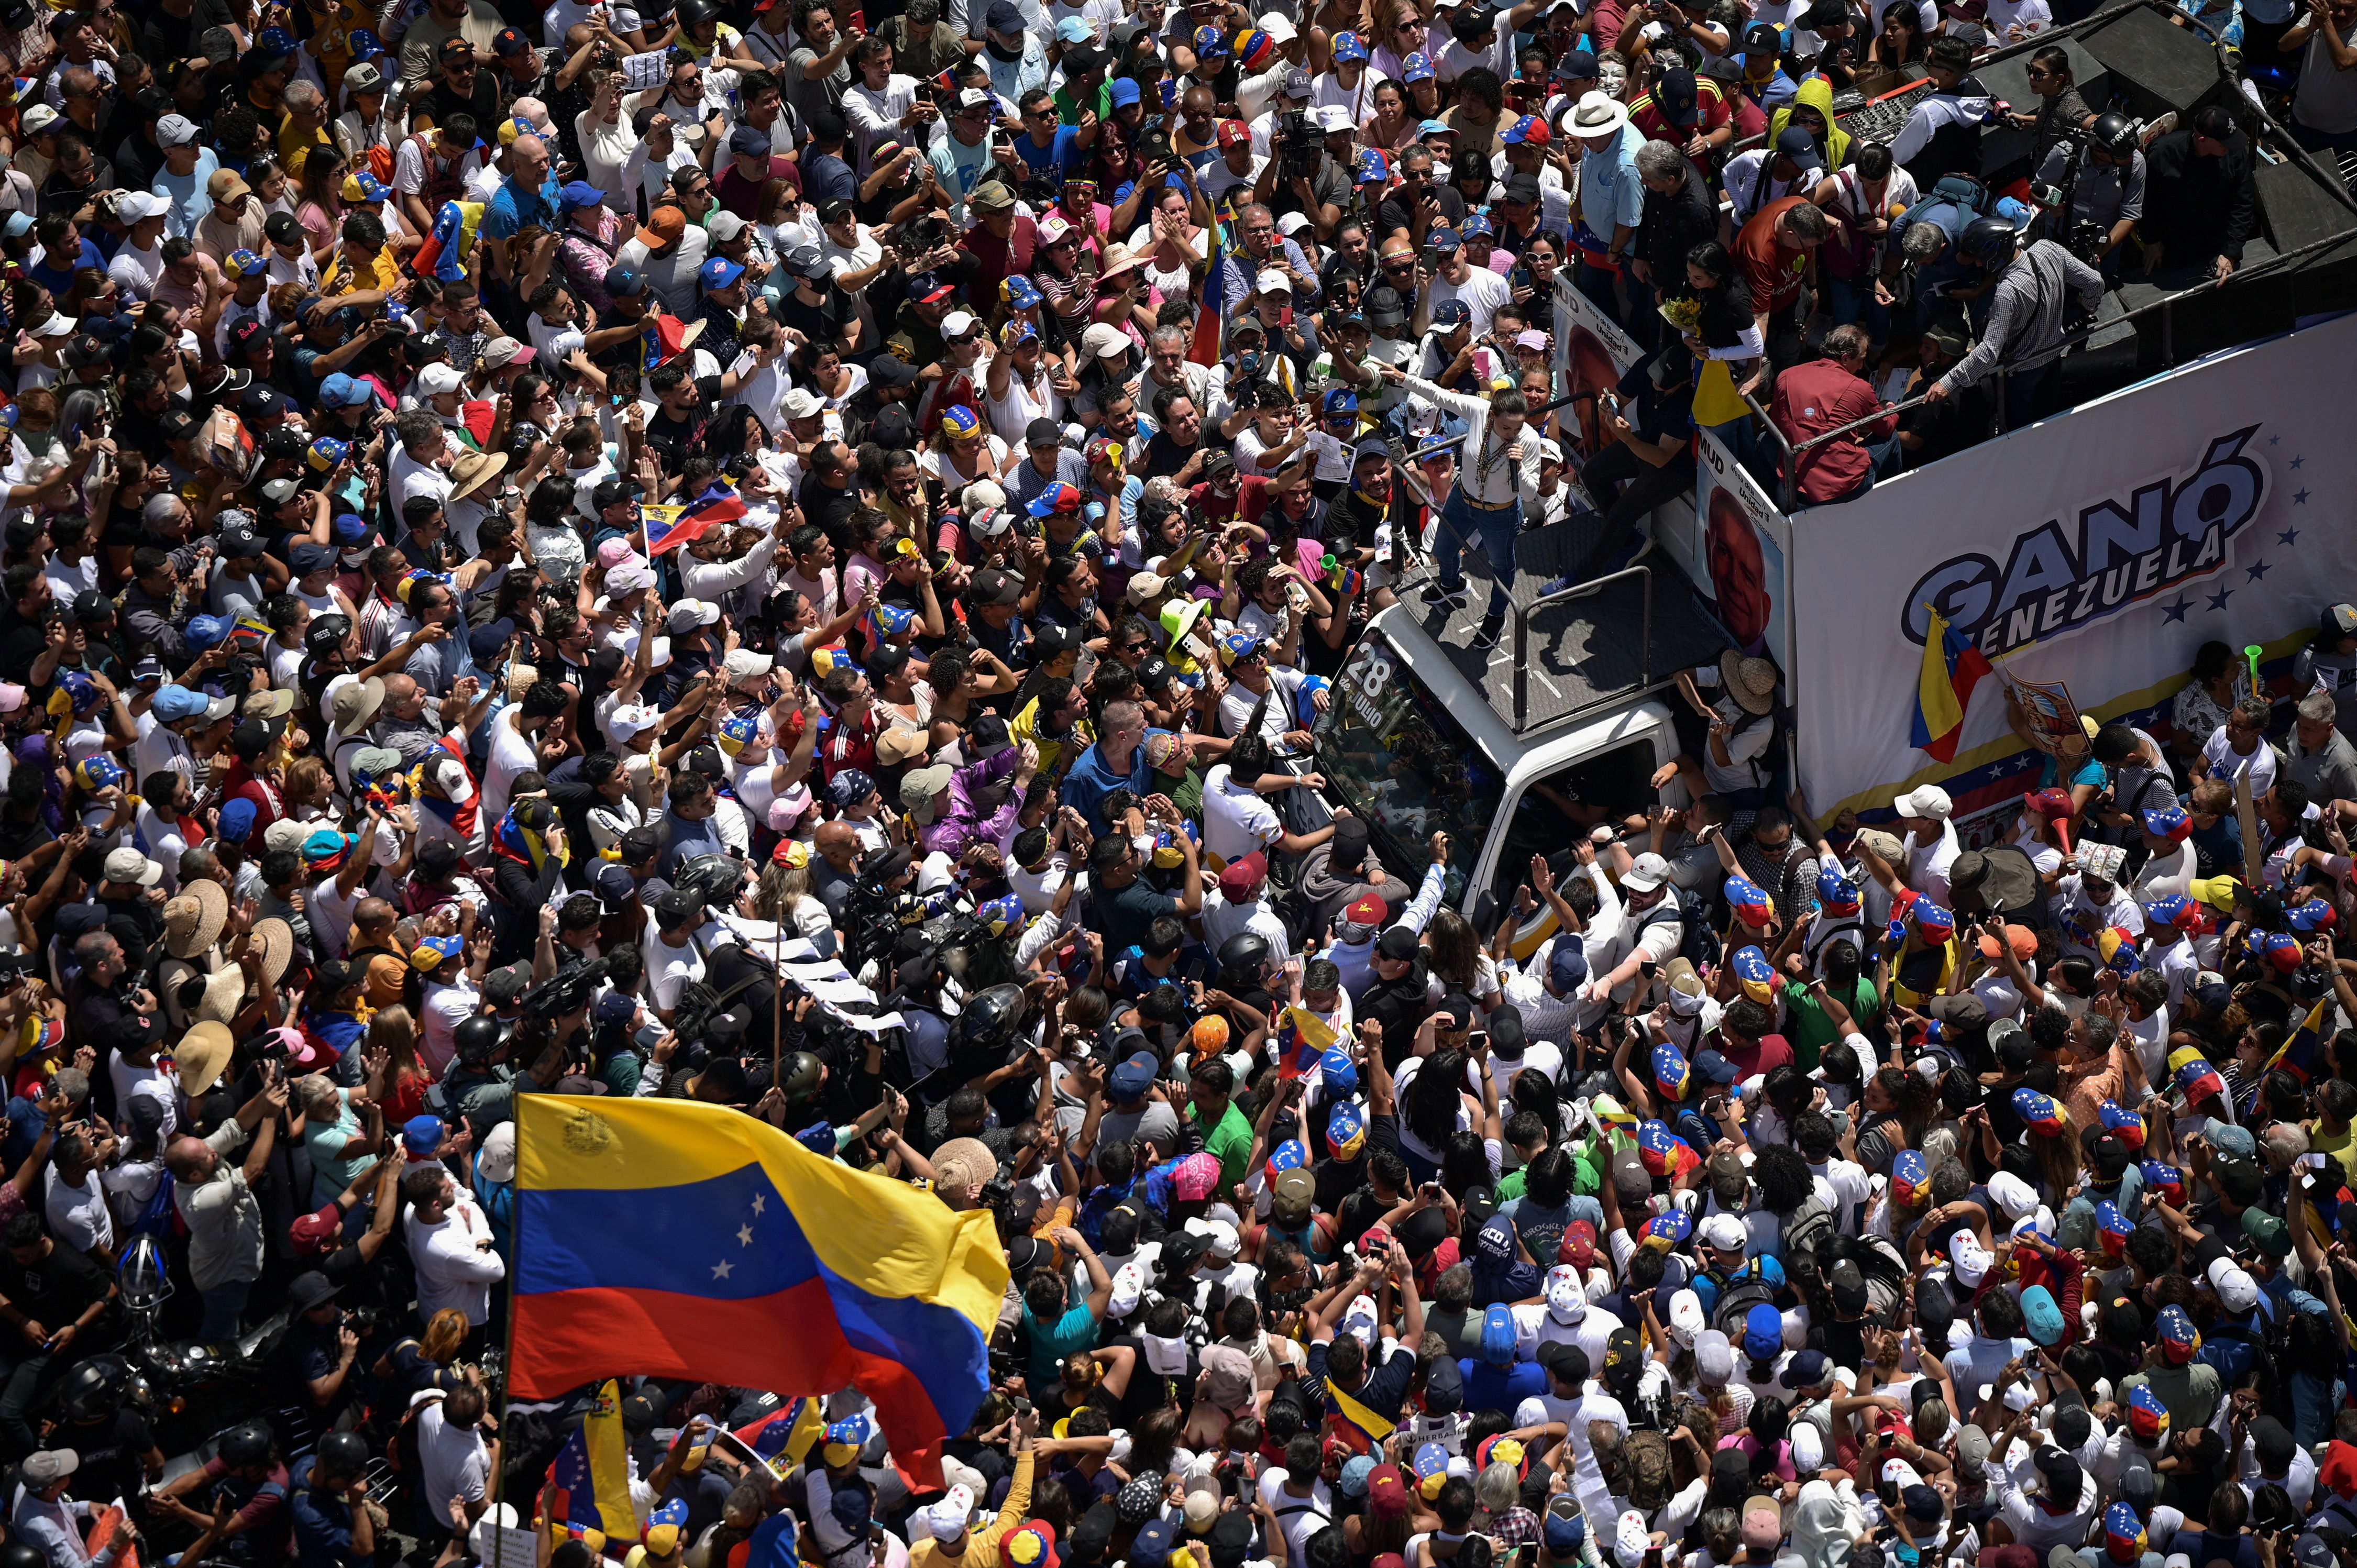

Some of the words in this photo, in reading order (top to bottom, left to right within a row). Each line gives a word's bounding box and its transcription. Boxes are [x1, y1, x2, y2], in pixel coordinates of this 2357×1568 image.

[1294, 77, 1310, 85] FLC
[1033, 161, 1060, 174] OMMY
[1584, 302, 1599, 320] Mesa
[1596, 323, 1622, 352] Unidad
[1609, 347, 1631, 370] Democrá
[1730, 464, 1744, 483] Mesa
[1739, 487, 1764, 518] Unidad
[1750, 512, 1778, 545] Democrática
[1904, 425, 2261, 642] GANÓ
[313, 628, 331, 642] PRESS
[1149, 660, 1163, 676] SoHo
[1347, 642, 1391, 697] 28
[2339, 669, 2356, 683] IKE
[1338, 673, 1351, 691] de
[1348, 691, 1383, 729] JULIO
